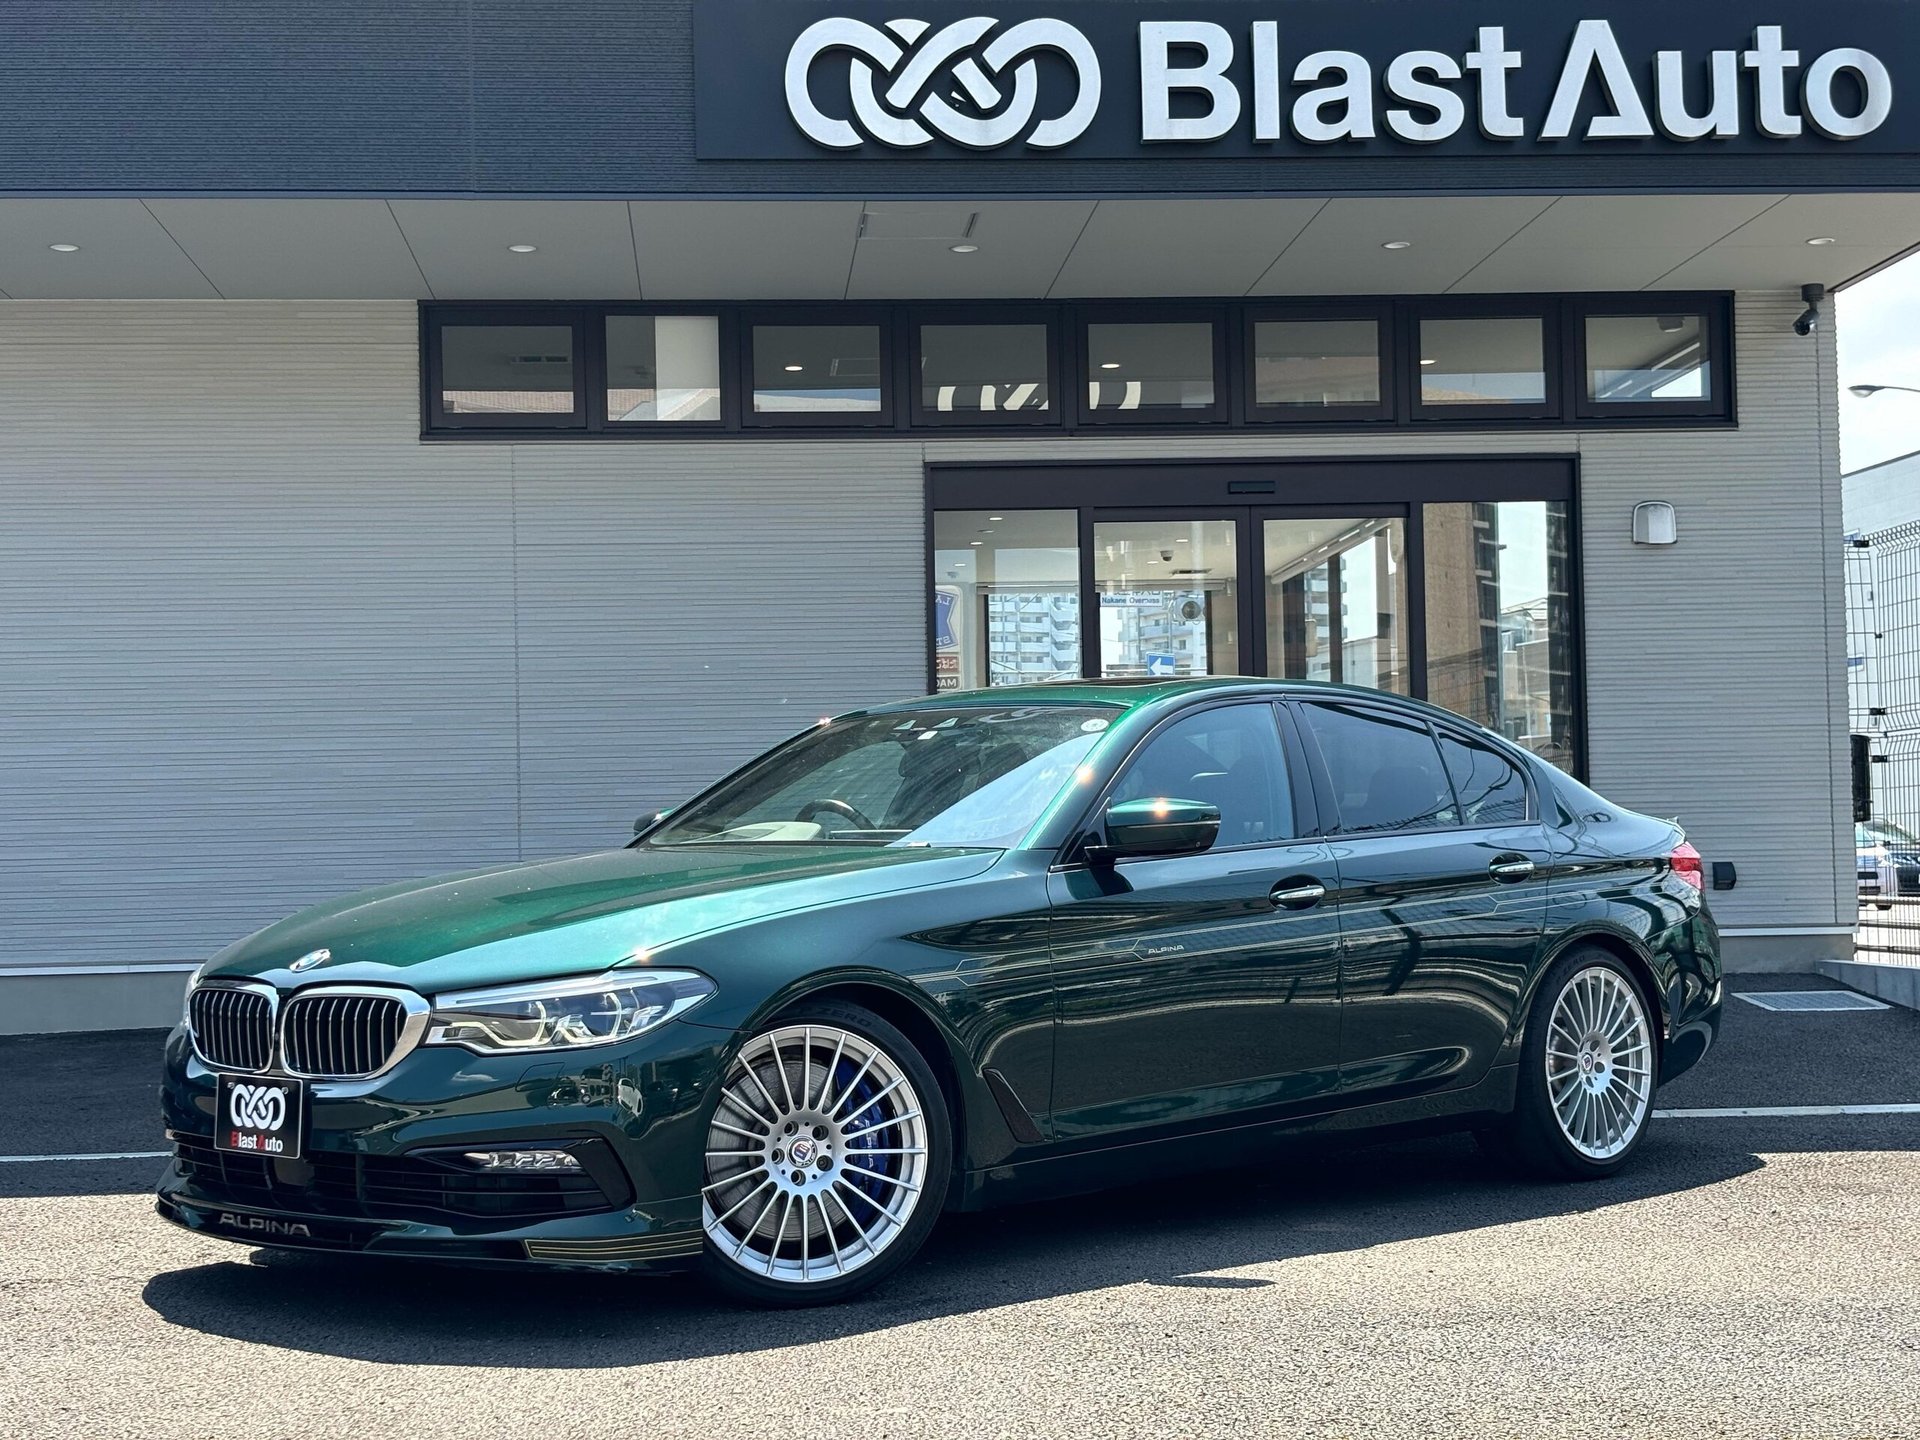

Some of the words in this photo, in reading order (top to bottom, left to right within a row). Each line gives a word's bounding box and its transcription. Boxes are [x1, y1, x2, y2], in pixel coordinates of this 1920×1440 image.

[1148, 944, 1185, 955] ALPINA
[815, 1007, 873, 1028] ZERO
[219, 1212, 312, 1238] ALPINA
